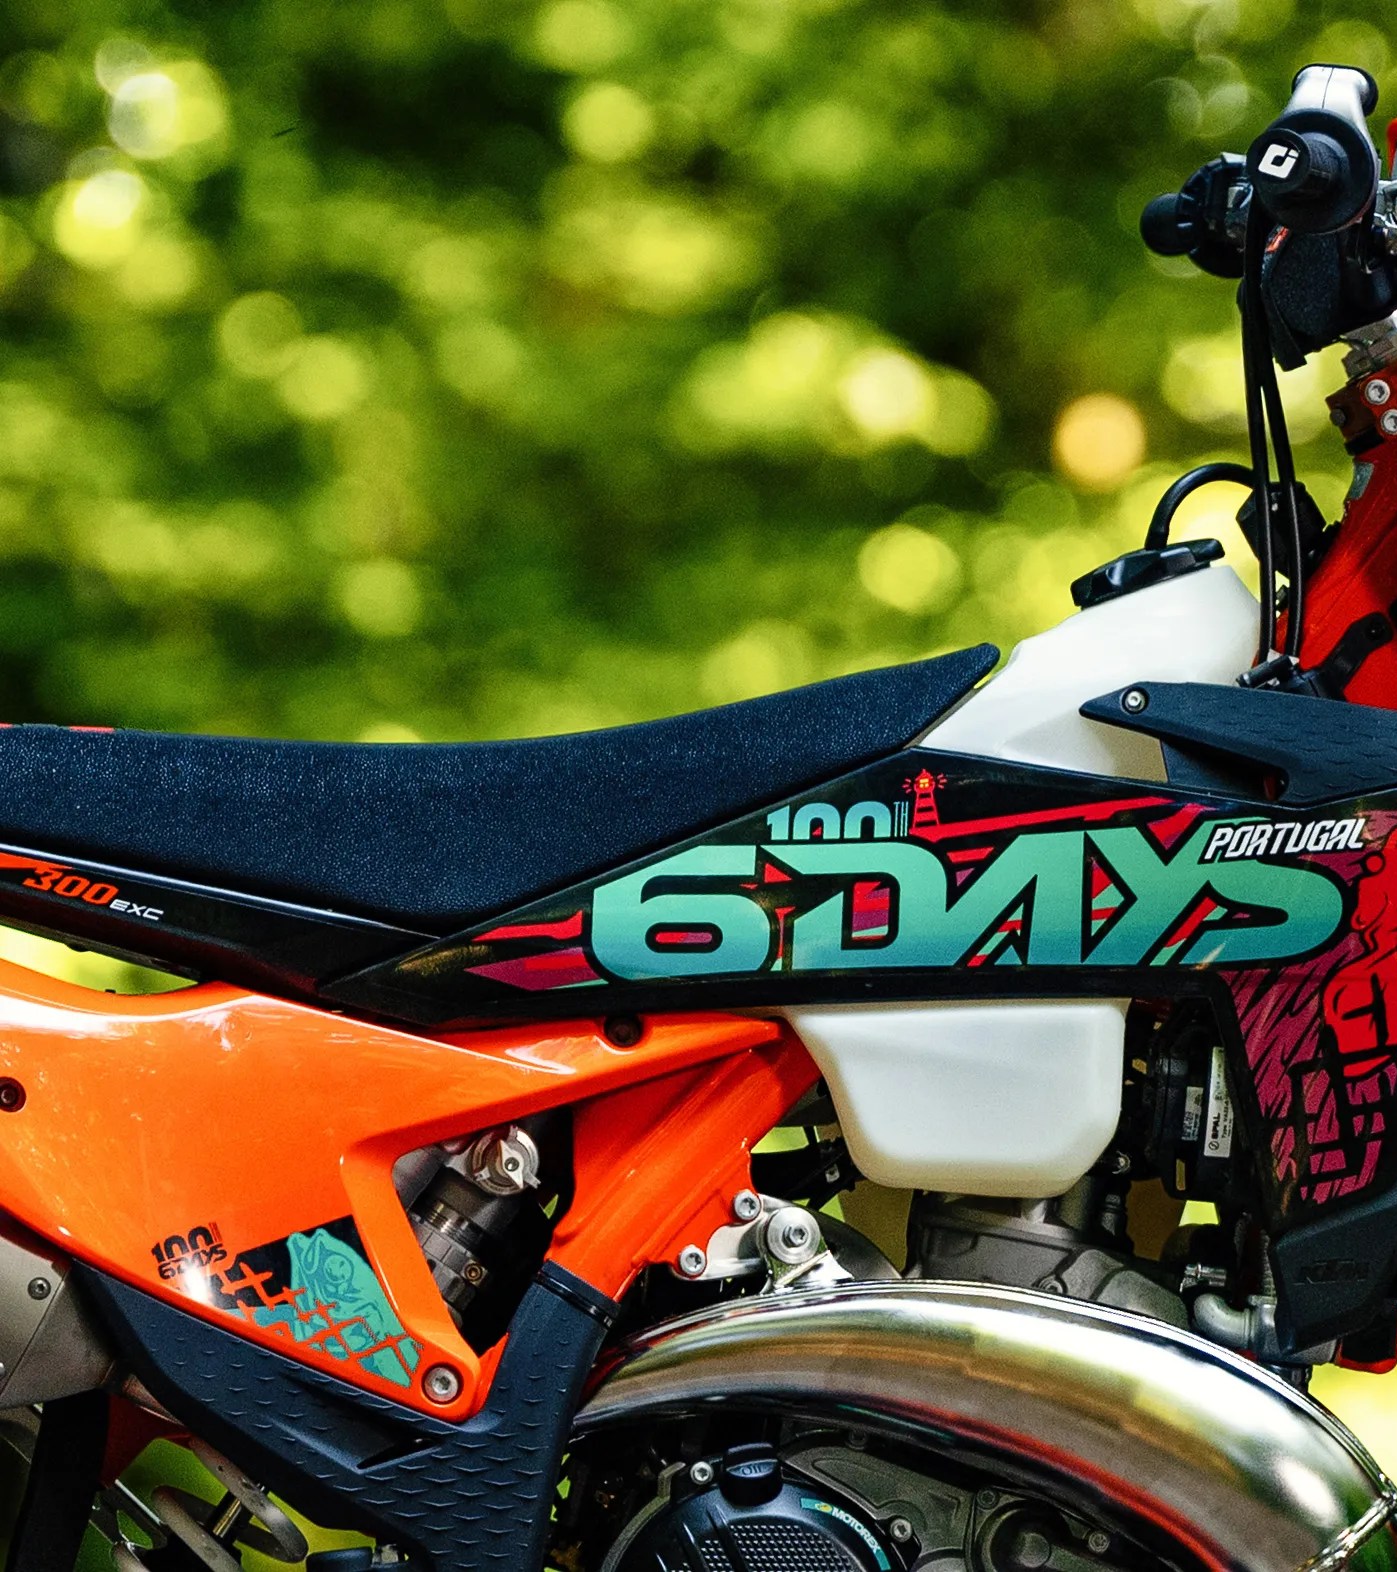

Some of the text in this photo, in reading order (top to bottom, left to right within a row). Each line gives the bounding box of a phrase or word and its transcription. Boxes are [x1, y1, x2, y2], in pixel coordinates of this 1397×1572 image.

[1204, 818, 1366, 860] PORTUGAL
[22, 866, 164, 921] 300 EXC
[831, 1506, 882, 1553] MOTOREX
